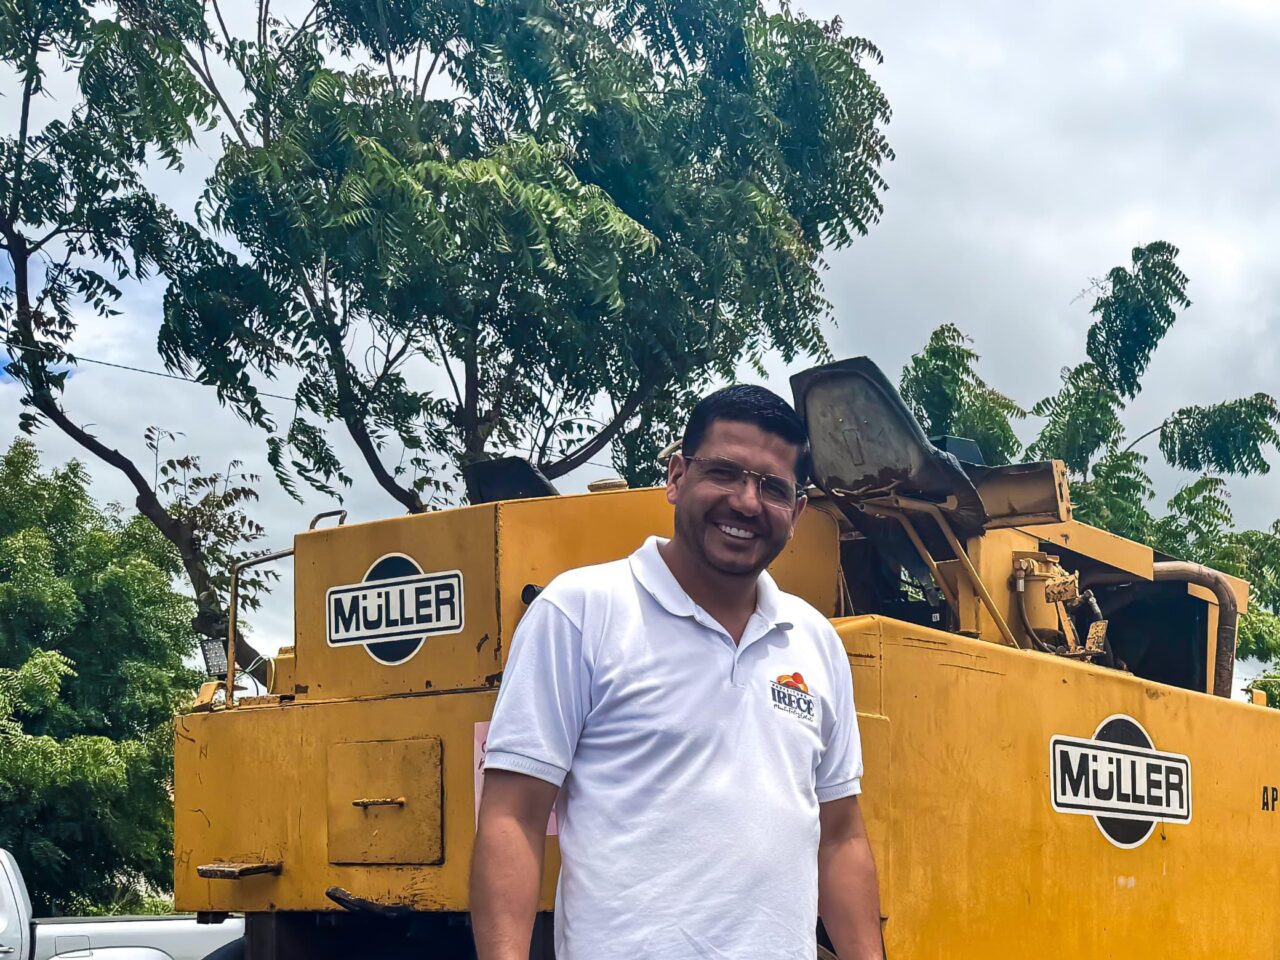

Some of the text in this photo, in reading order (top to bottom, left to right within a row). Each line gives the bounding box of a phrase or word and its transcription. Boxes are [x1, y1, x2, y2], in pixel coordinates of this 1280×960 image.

[334, 582, 456, 634] MÜLLER
[1060, 750, 1184, 809] MÜLLER
[1262, 786, 1278, 811] AP
